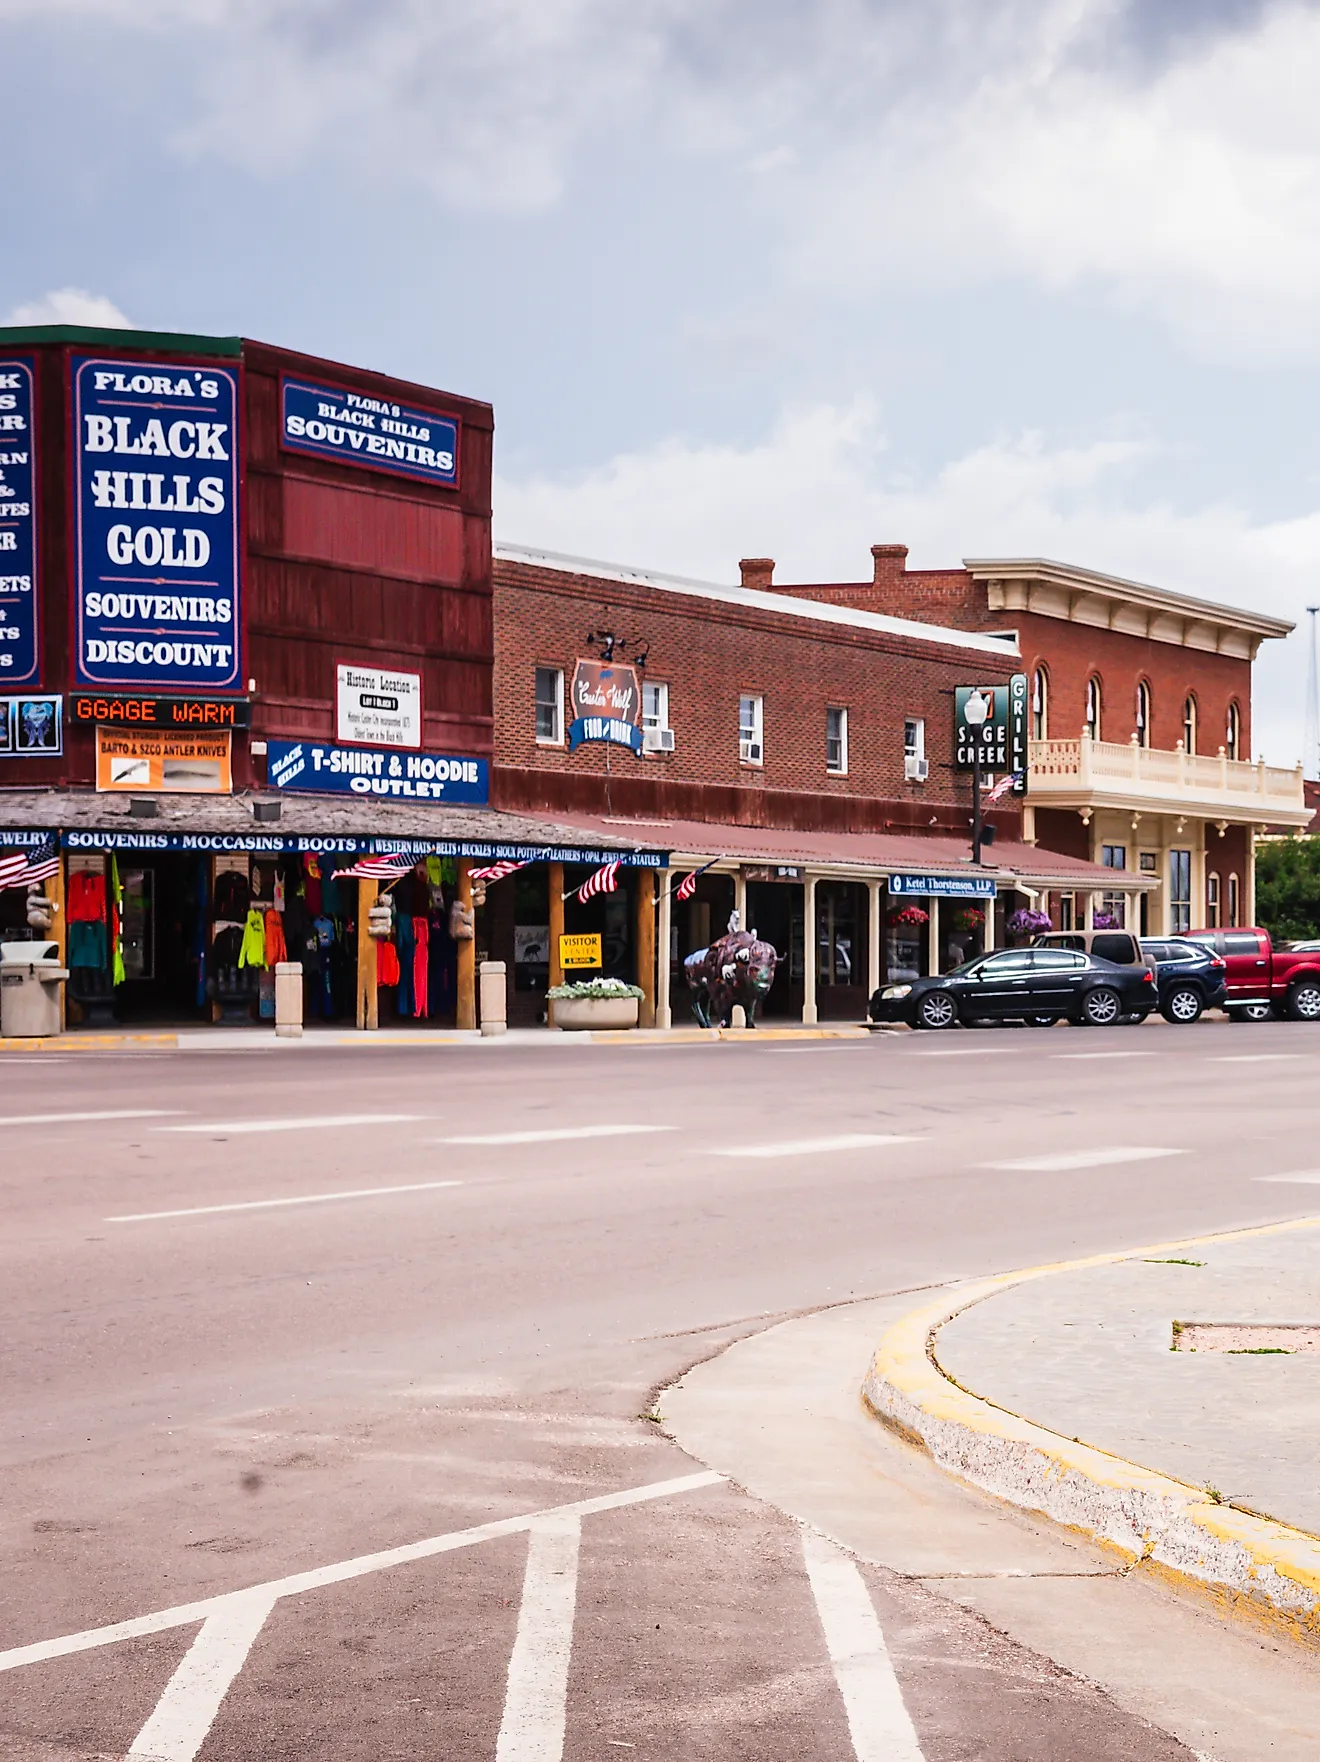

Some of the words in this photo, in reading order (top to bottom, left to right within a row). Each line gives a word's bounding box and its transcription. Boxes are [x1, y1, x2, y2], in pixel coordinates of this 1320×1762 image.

[94, 372, 220, 399] FLORA'S
[346, 393, 401, 418] FLORA'S
[317, 402, 376, 430] BLACK
[380, 418, 431, 442] HILLS
[84, 413, 230, 461] BLACK
[286, 415, 453, 471] SOUVENIRS
[90, 470, 225, 515] HILLS
[106, 523, 211, 568] GOLD
[85, 592, 232, 623] SOUVENIRS
[86, 639, 232, 668] DISCOUNT
[77, 699, 157, 722] GGAGE
[172, 702, 236, 725] WARM
[958, 726, 1006, 743] SGE
[101, 742, 130, 754] BARTO
[131, 745, 138, 755] &
[163, 745, 196, 757] ANTLER
[196, 746, 227, 757] KNIVES
[271, 743, 303, 776] BLACK
[957, 746, 1006, 764] CREEK
[277, 758, 305, 787] HILLS
[311, 748, 385, 776] T-SHIRT
[388, 757, 403, 777] &
[407, 757, 479, 783] HOODIE
[350, 776, 444, 798] OUTLET
[67, 832, 169, 848] SOUVENIRS
[182, 834, 284, 850] MOCCASINS
[298, 838, 357, 852] BOOTS
[375, 838, 412, 854] WESTERN
[412, 840, 432, 854] HATS
[436, 841, 457, 856] BELTS
[461, 843, 492, 857] BUCKLES
[496, 844, 516, 858] SIOUX
[550, 847, 581, 861] LEATHERS
[585, 851, 600, 863] OPAL
[632, 853, 661, 867] STATUES
[975, 880, 992, 891] LLP
[564, 937, 598, 946] VISITOR
